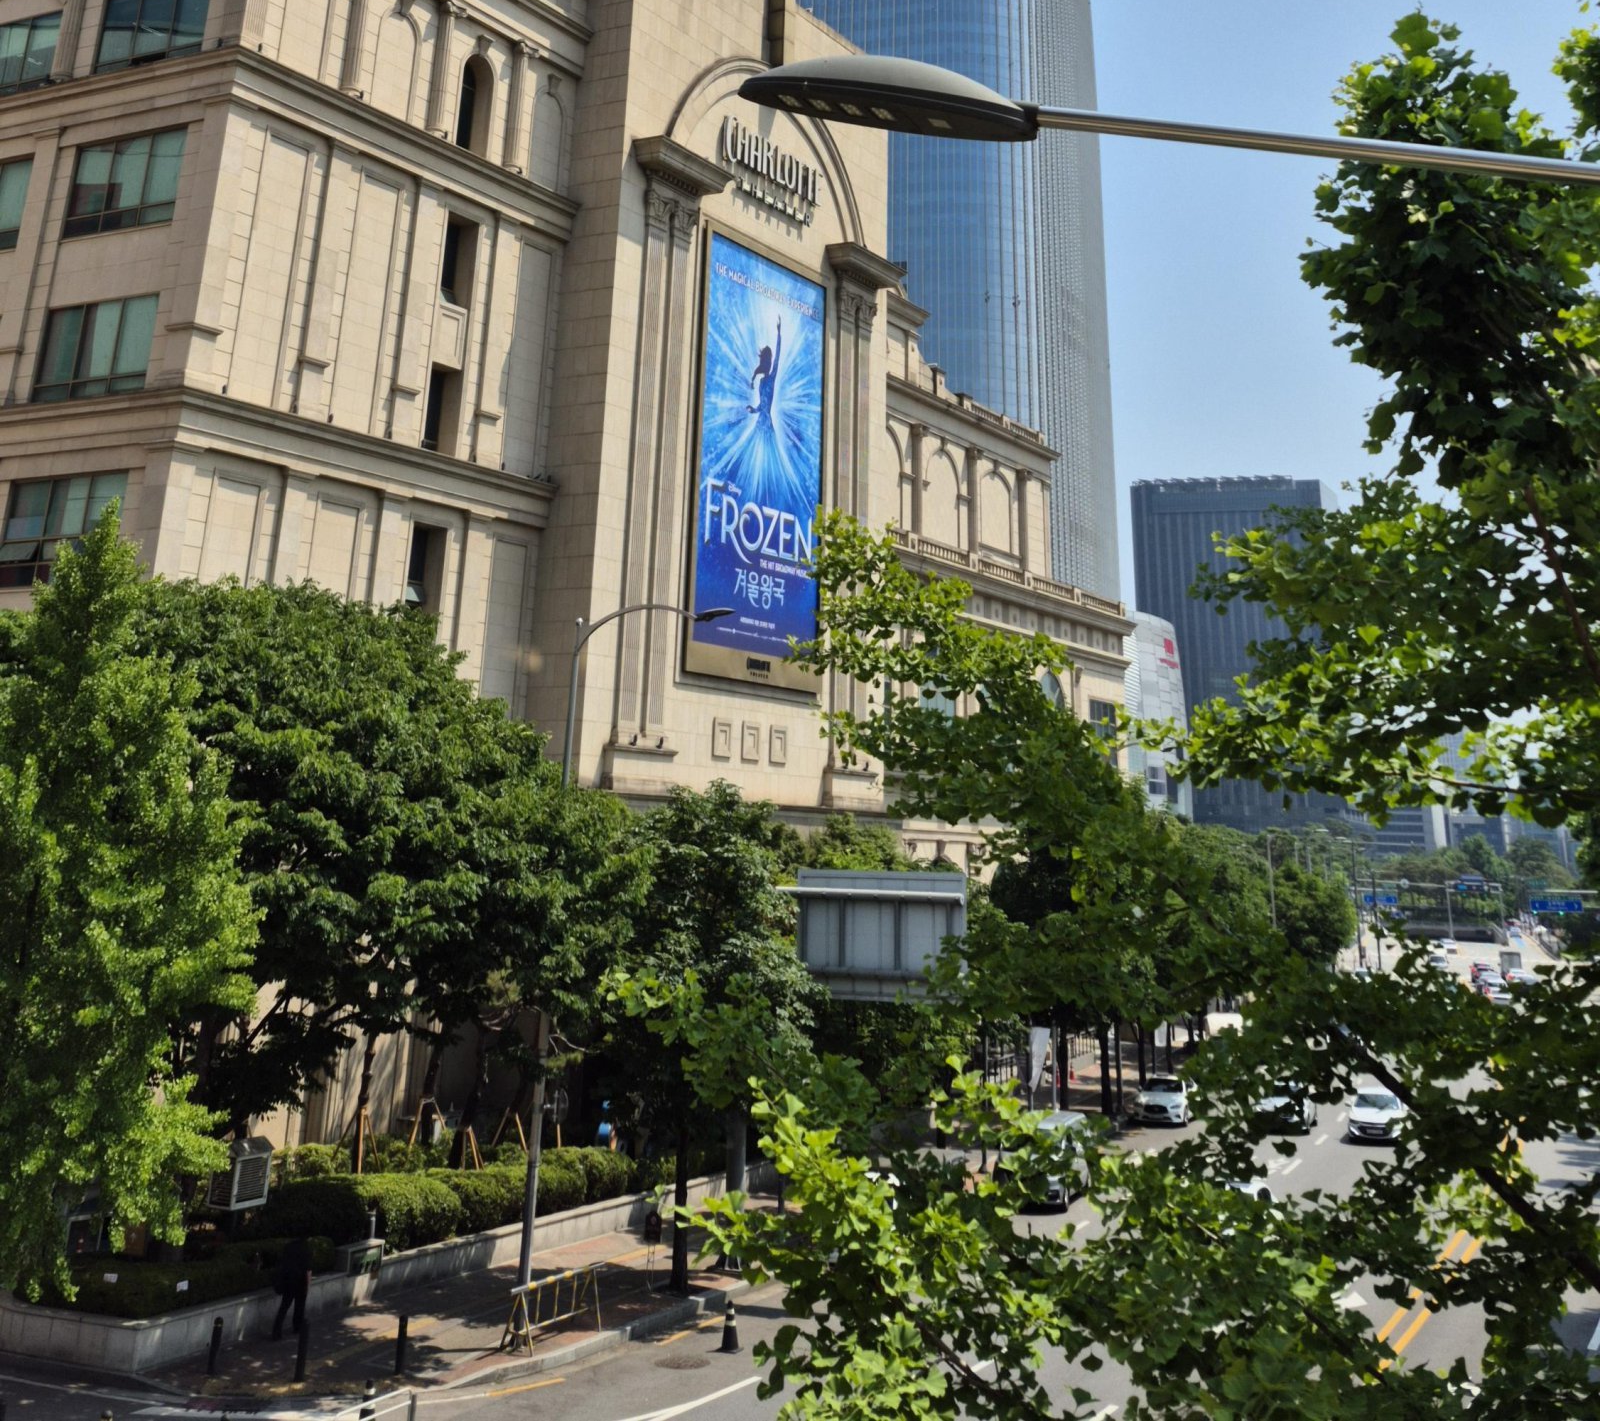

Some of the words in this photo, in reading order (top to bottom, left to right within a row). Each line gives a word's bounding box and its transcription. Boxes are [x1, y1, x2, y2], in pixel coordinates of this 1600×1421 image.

[724, 115, 823, 207] CHARLOTTE
[736, 175, 811, 229] THEATER
[715, 262, 727, 277] THE
[728, 268, 753, 290] MAGICAL
[704, 476, 813, 565] FROZEN
[733, 567, 786, 610] 겨울왕국
